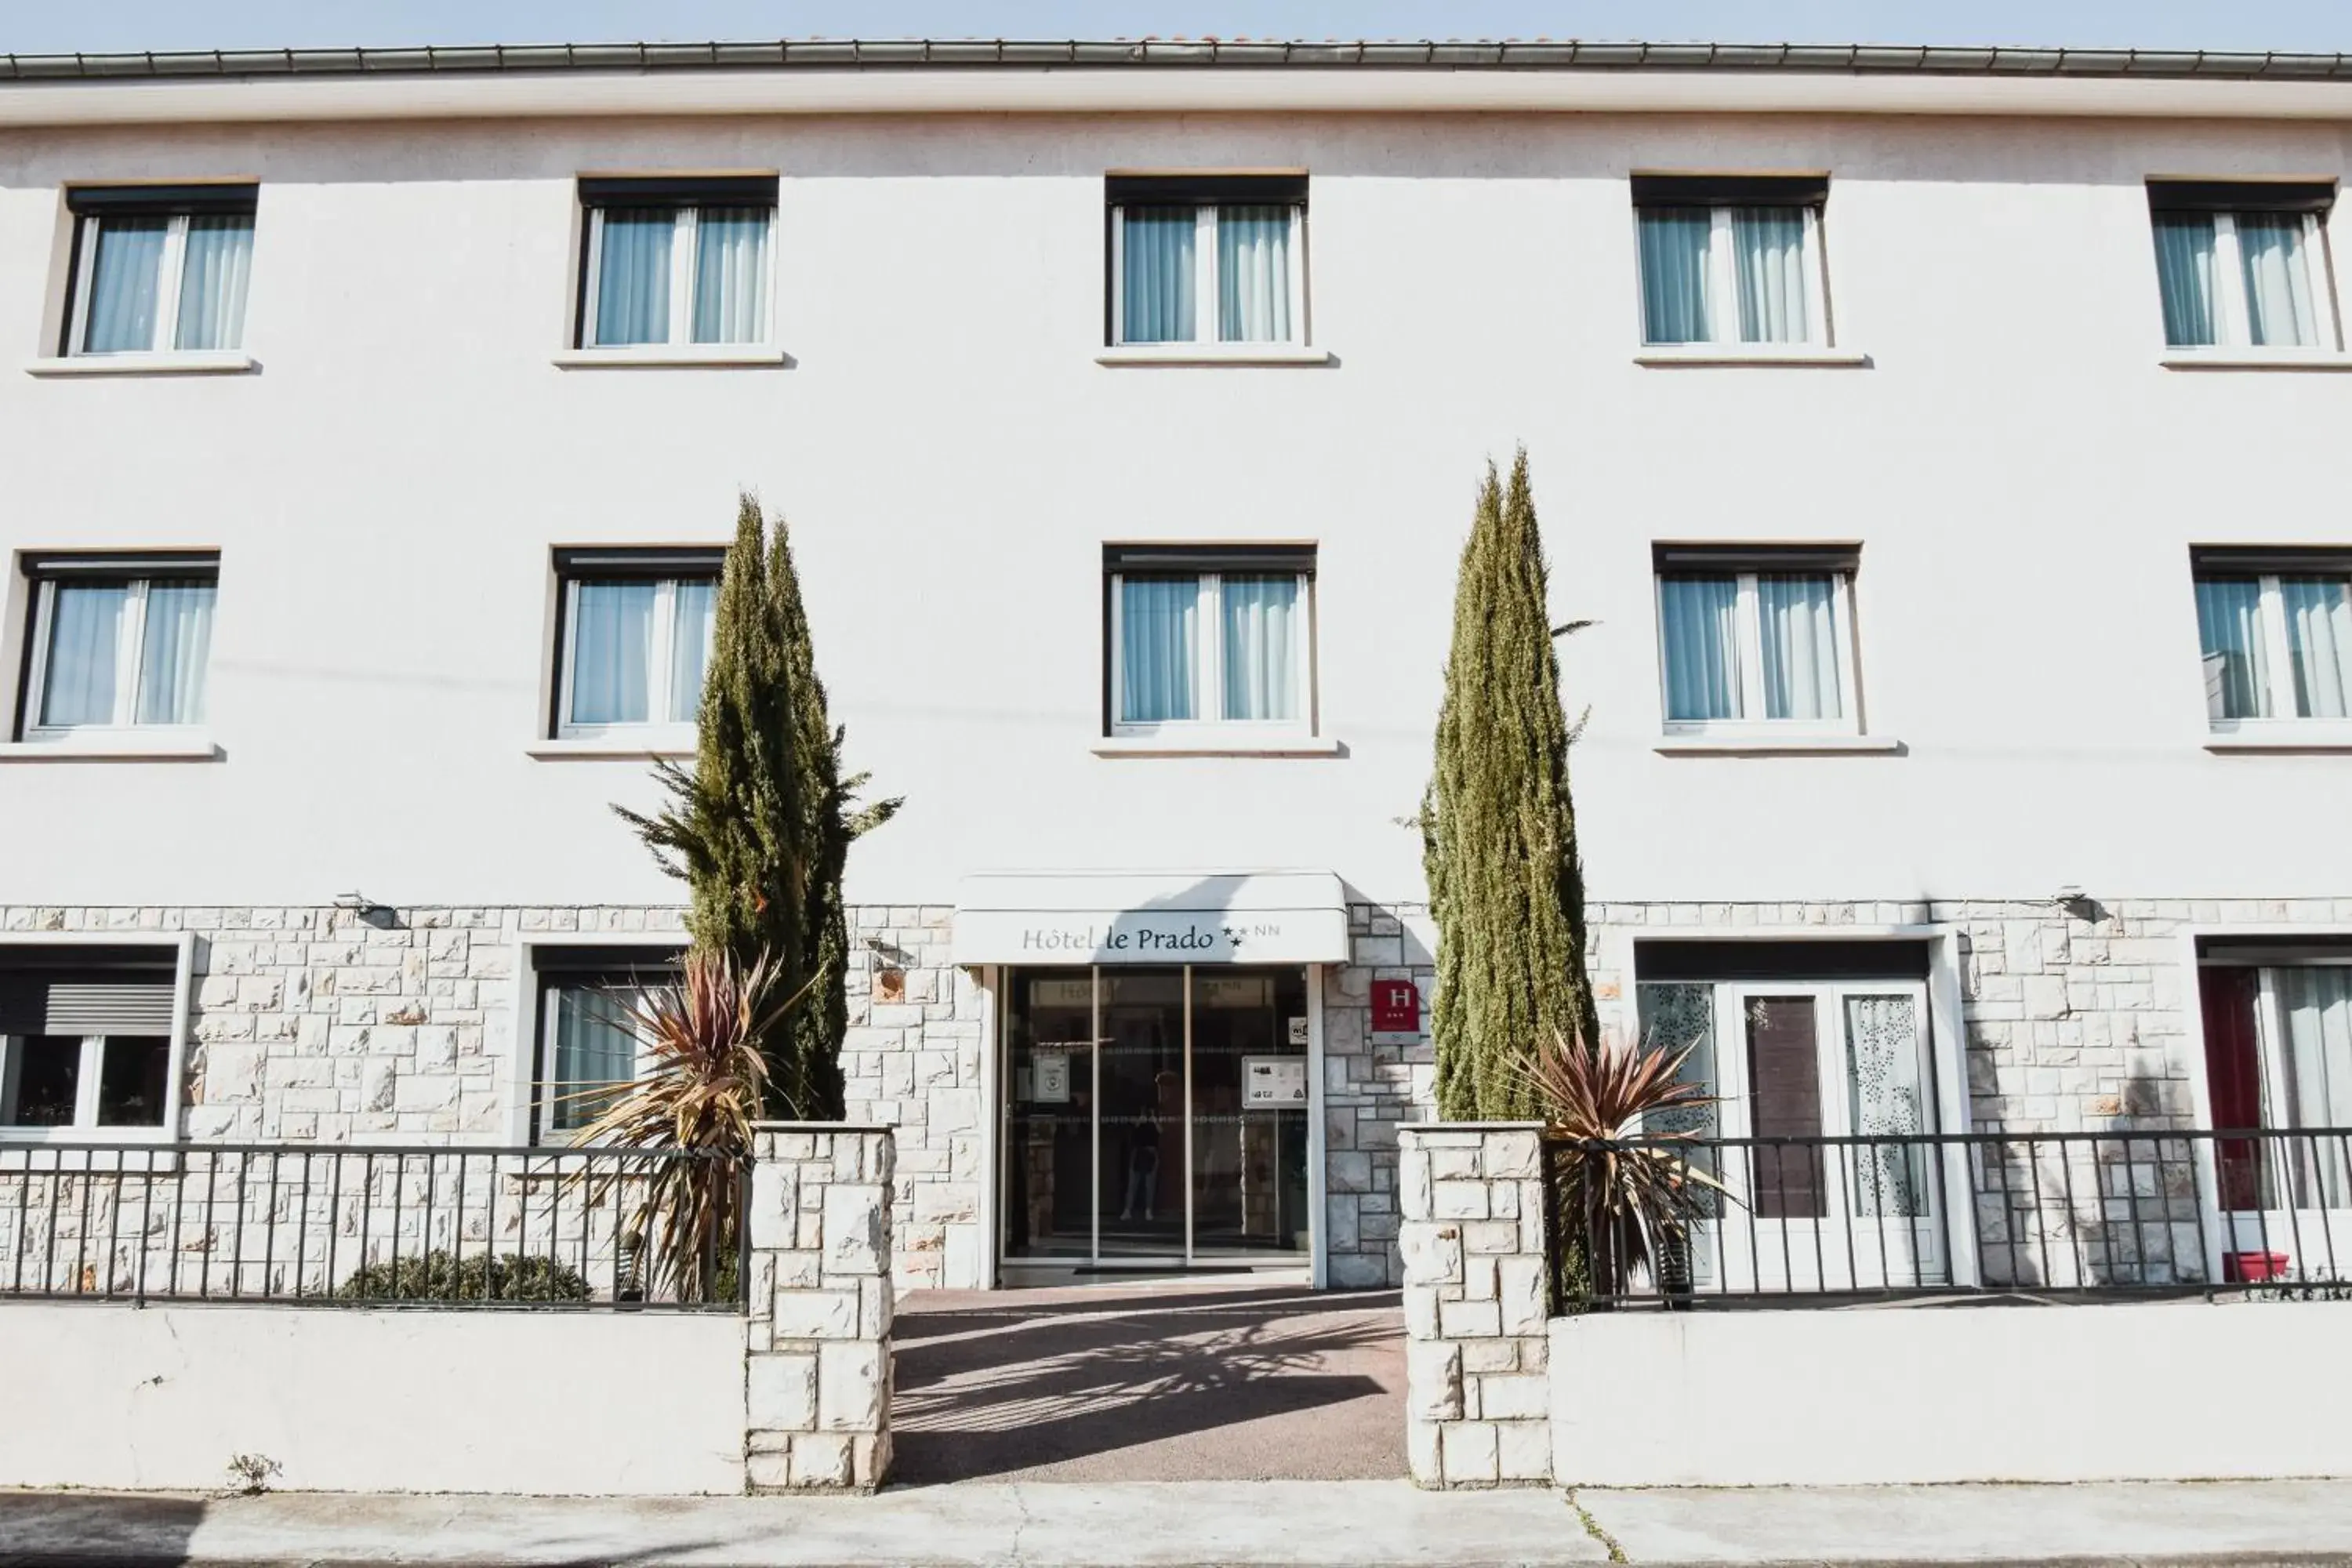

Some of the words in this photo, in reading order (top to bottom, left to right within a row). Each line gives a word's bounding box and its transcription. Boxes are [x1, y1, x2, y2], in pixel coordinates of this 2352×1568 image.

[1023, 925, 1094, 949] Hôtel
[1106, 925, 1129, 949] le
[1137, 925, 1214, 949] Prado
[1255, 925, 1279, 935] NN
[1390, 989, 1410, 1007] H
